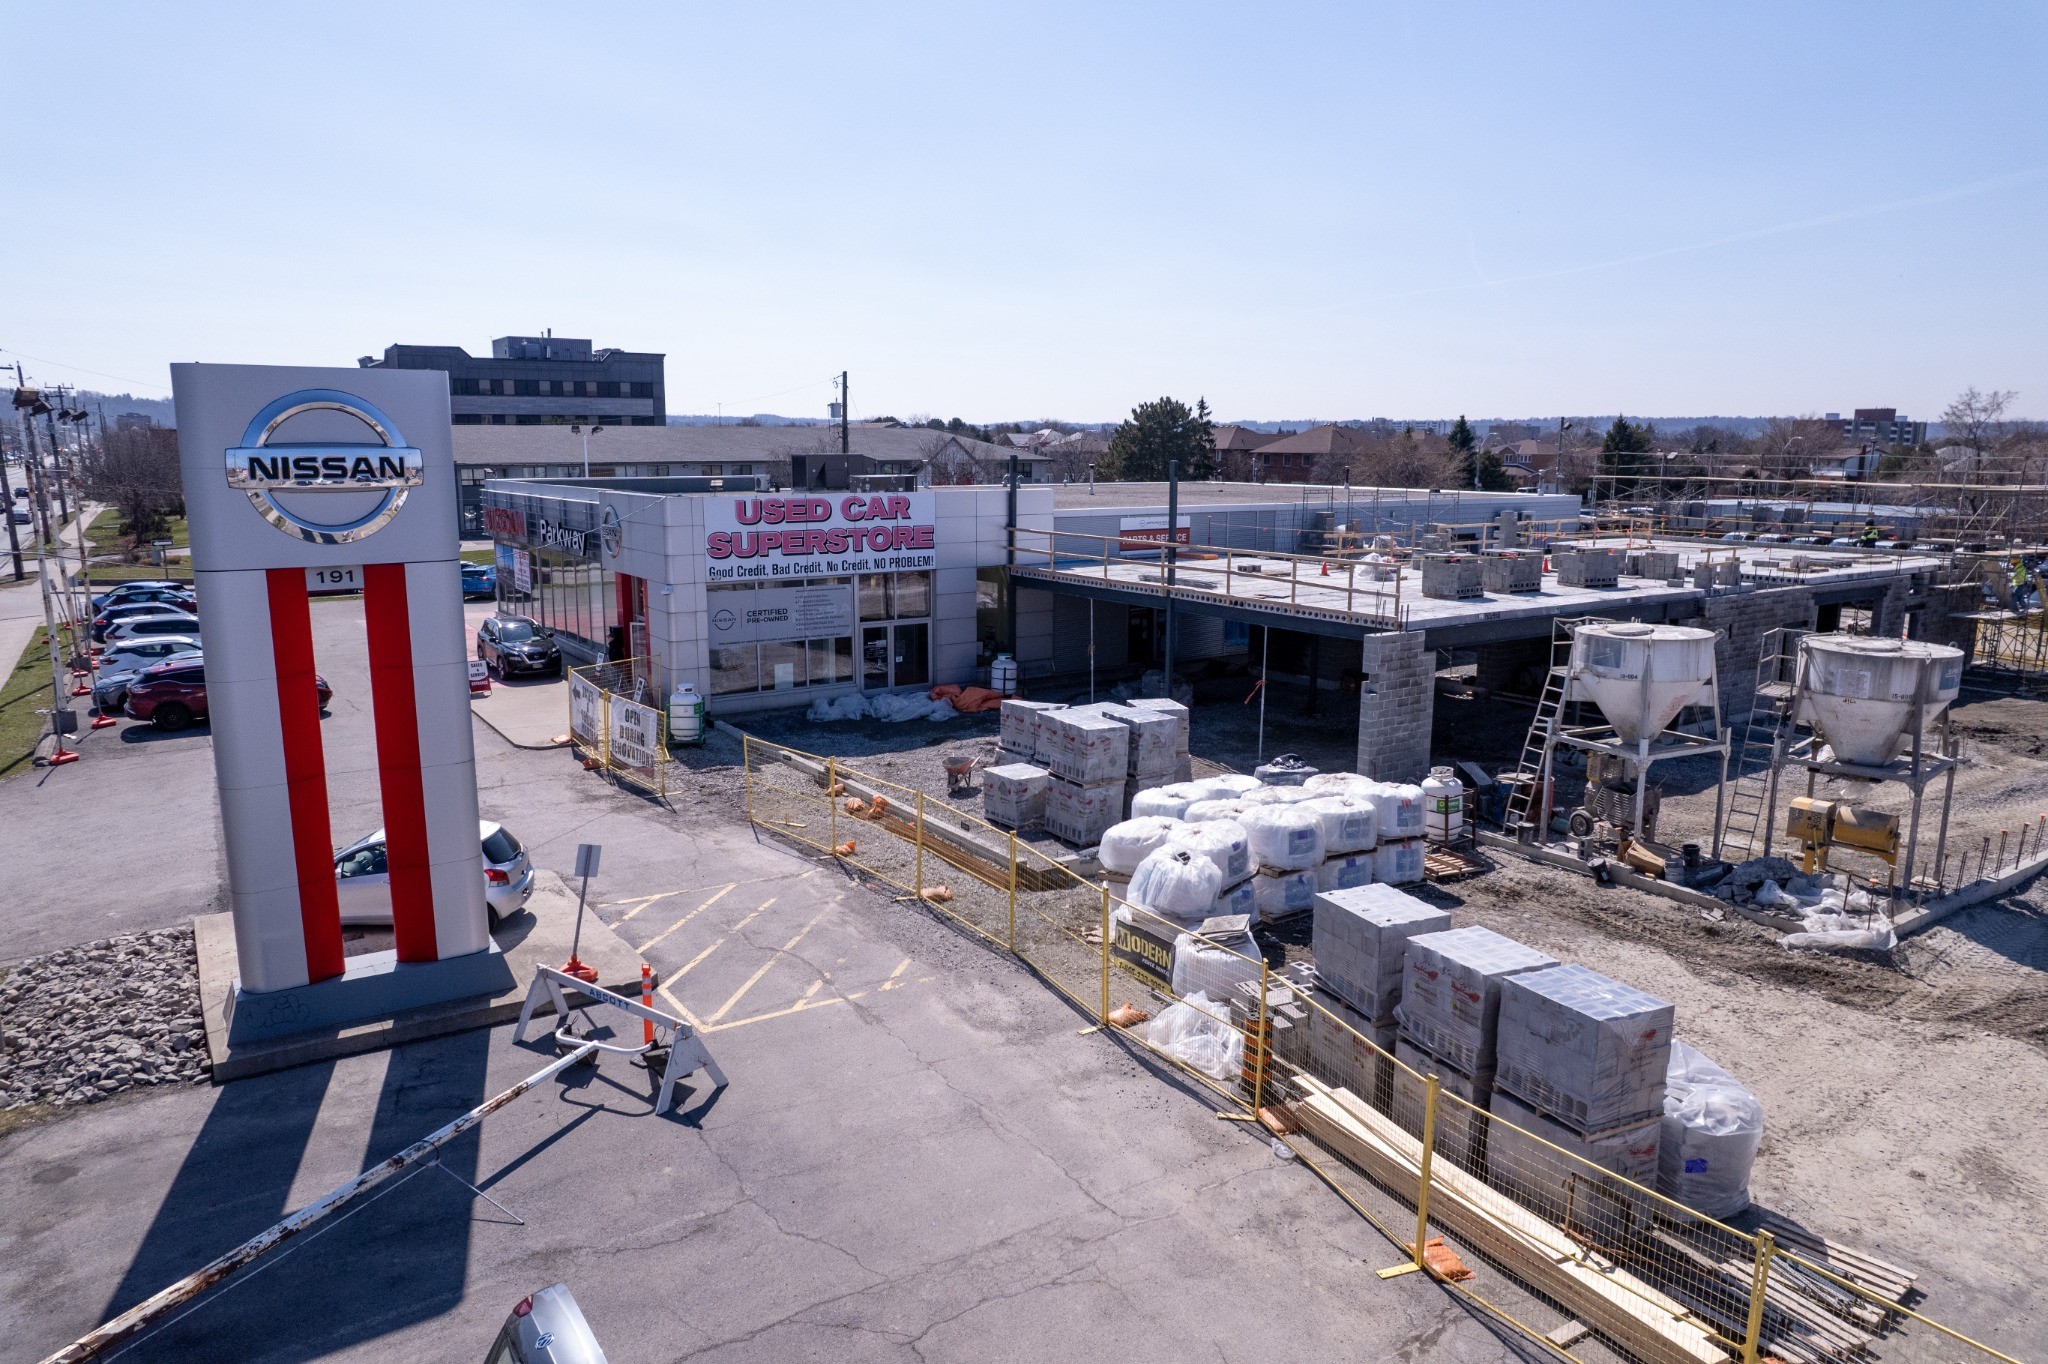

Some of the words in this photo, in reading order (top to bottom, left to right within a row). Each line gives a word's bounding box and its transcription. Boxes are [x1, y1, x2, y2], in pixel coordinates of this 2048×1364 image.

[249, 456, 405, 480] NISSAN
[735, 498, 832, 525] USED
[840, 495, 912, 521] CAR
[540, 519, 587, 556] Parkway
[707, 525, 934, 559] SUPERSTORE
[1156, 533, 1187, 542] SERCE
[316, 570, 354, 583] 191
[709, 566, 734, 579] Good
[737, 564, 769, 577] Credit,
[772, 563, 790, 575] Bad
[793, 561, 823, 574] Credit,
[827, 560, 838, 572] No
[841, 560, 871, 571] Credit,
[874, 558, 886, 569] NO
[889, 555, 934, 568] PROBLEM!
[747, 608, 788, 617] CERTIFIED
[747, 615, 789, 624] PRE-OWNED
[625, 708, 641, 727] OPEN
[620, 725, 645, 746] DURING
[611, 738, 654, 768] RENOVATIONS
[1116, 926, 1171, 969] MODERN
[589, 988, 630, 1010] ABCOTT
